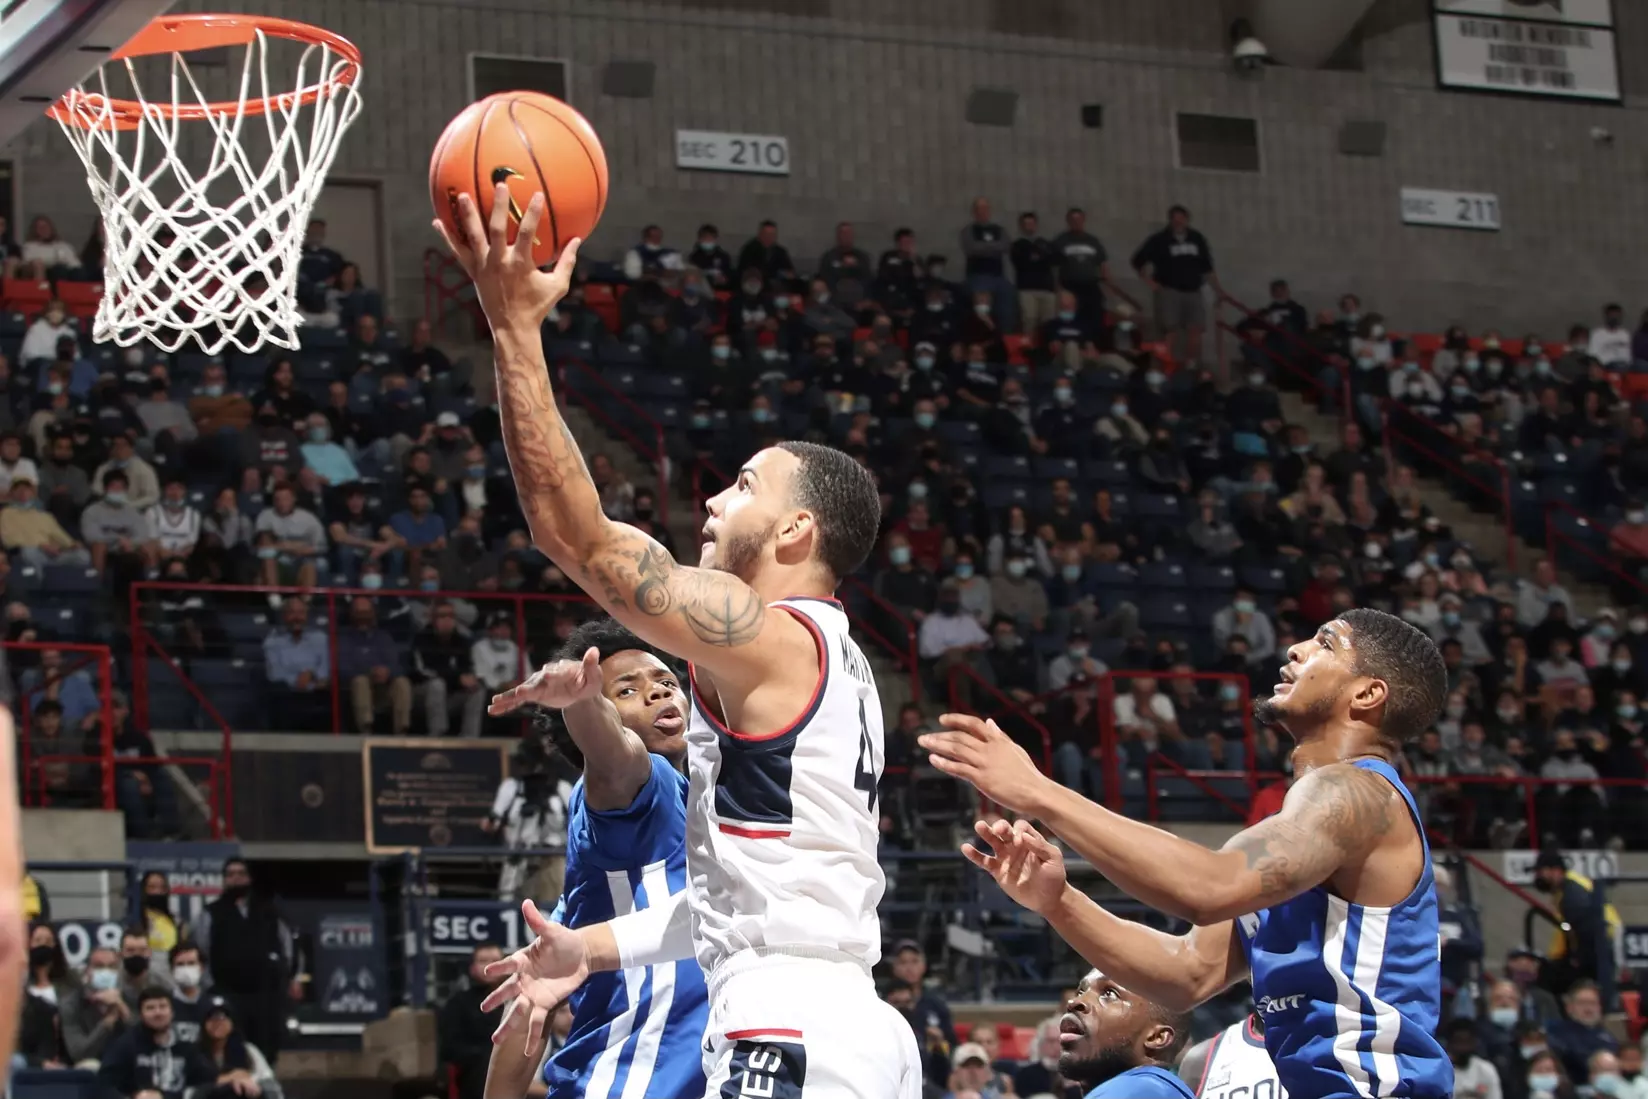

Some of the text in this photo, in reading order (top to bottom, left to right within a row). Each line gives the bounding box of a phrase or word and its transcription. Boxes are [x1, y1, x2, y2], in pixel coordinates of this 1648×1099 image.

[680, 140, 785, 167] SEC 210
[1457, 197, 1498, 222] 211
[853, 699, 878, 814] 4
[433, 916, 489, 941] SEC
[739, 1045, 782, 1099] ES
